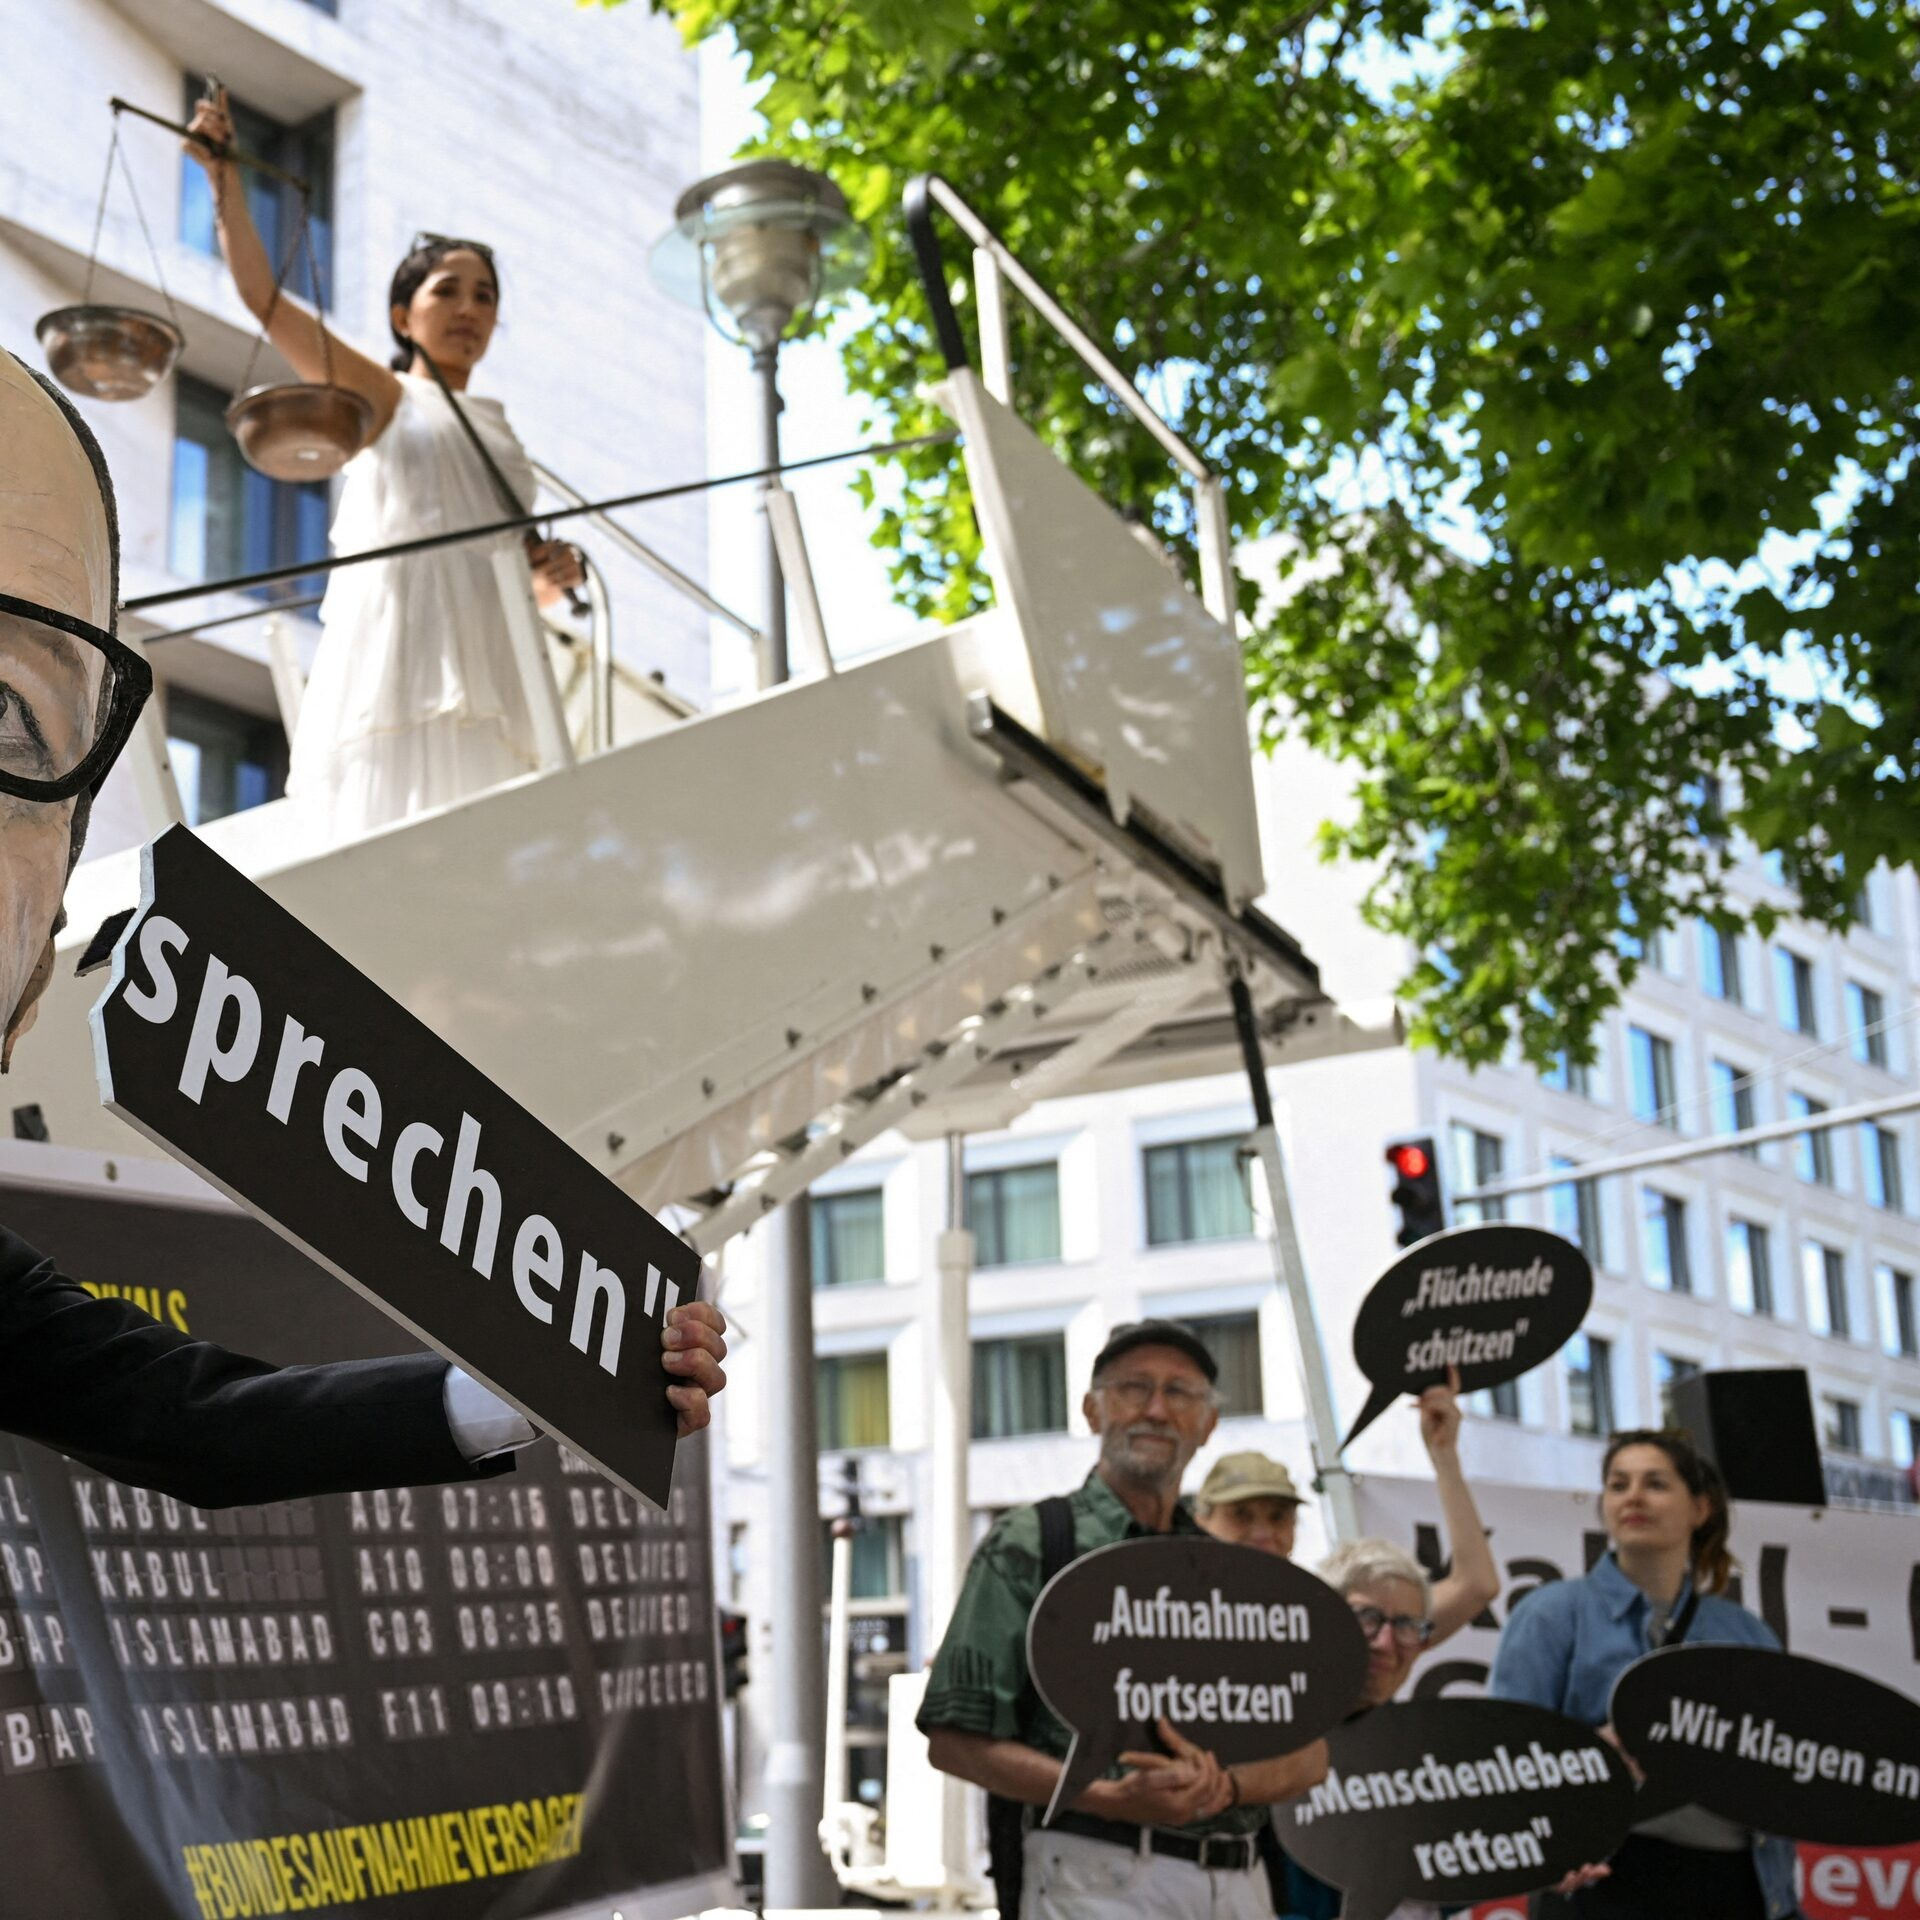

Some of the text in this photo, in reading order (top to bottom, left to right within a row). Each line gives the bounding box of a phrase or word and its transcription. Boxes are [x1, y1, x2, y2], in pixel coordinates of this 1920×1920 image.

[122, 916, 680, 1377] sprechen"
[442, 1487, 546, 1530] 07:15
[92, 1550, 220, 1598] KABUL
[360, 1548, 424, 1592] A10
[450, 1544, 555, 1589] 08:00
[114, 1615, 333, 1665] ISLAMABAD
[367, 1609, 433, 1654] C03
[459, 1602, 564, 1648] 08:35
[1093, 1585, 1310, 1643] „Aufnahmen
[141, 1698, 351, 1755] ISLAMABAD
[381, 1687, 447, 1737] F11
[471, 1676, 577, 1727] 09:10
[1114, 1668, 1307, 1723] fortsetzen"
[1648, 1696, 1733, 1751] „Wir
[1737, 1713, 1865, 1786] klagen
[1295, 1741, 1611, 1825] „Menschenleben
[1414, 1816, 1552, 1880] retten"
